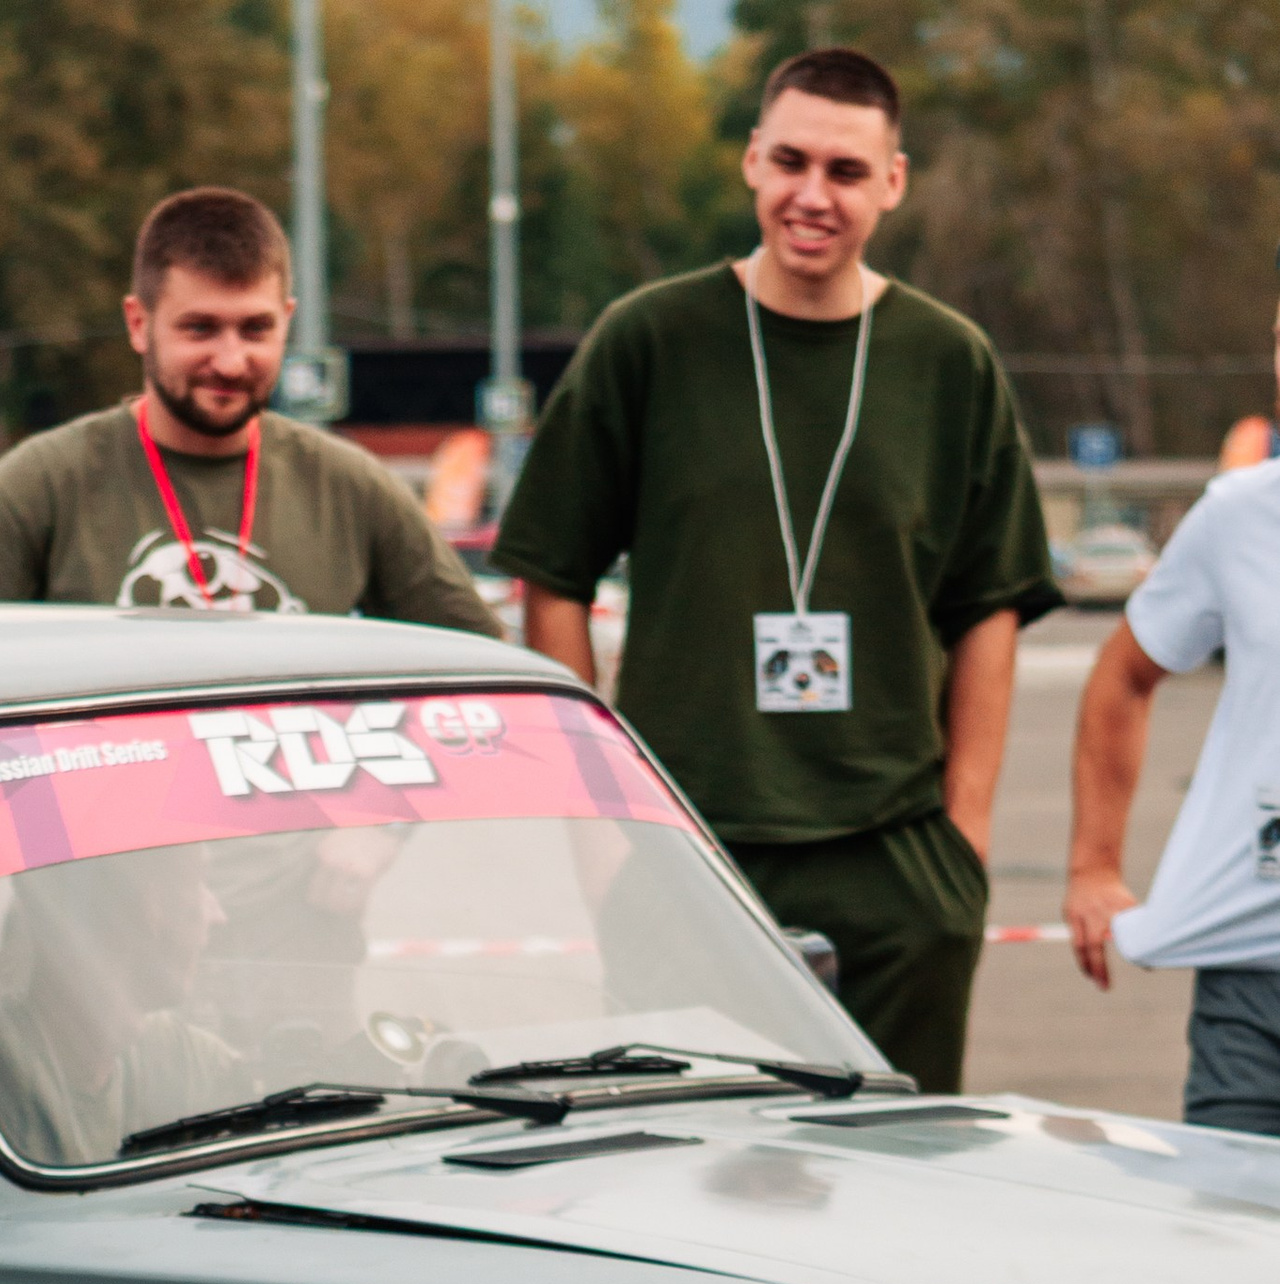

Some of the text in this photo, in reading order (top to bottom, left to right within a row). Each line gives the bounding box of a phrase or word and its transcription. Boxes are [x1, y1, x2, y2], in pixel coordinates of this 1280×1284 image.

[55, 746, 101, 772] Drift
[101, 741, 167, 768] Series
[187, 700, 505, 797] RDS GP
